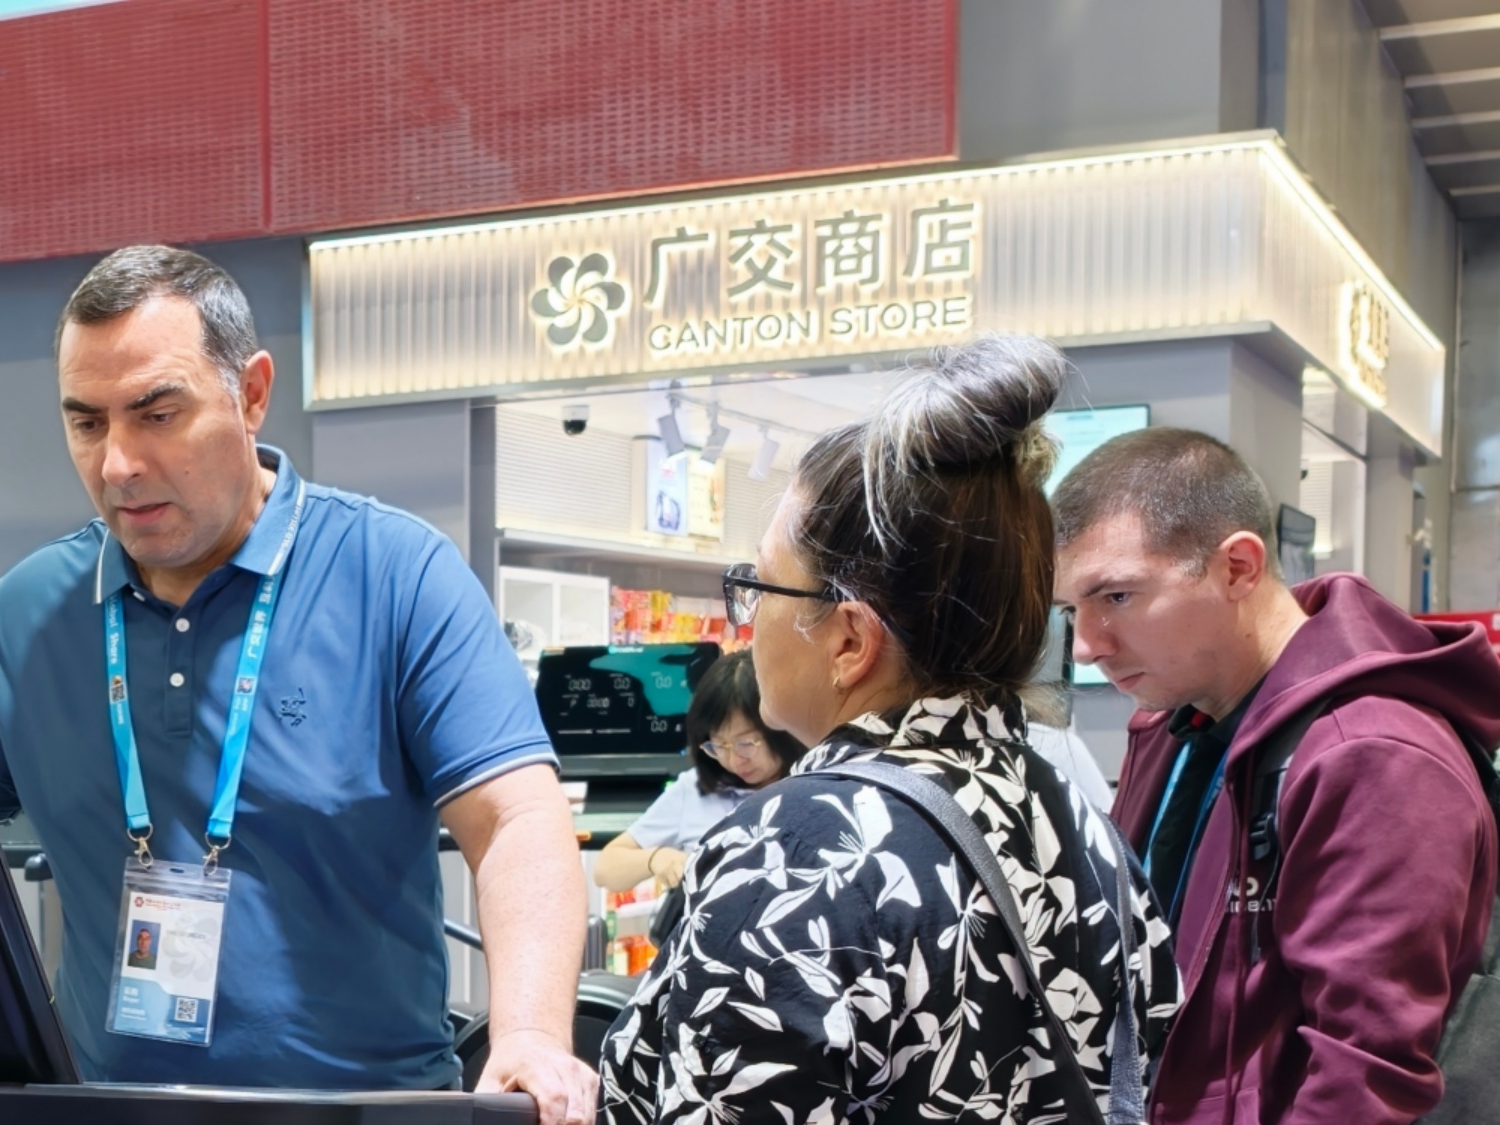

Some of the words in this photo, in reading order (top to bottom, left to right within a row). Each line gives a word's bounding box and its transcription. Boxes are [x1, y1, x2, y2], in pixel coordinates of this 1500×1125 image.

[643, 198, 975, 309] 广交商店
[650, 310, 812, 351] CANTON
[830, 296, 968, 335] STORE
